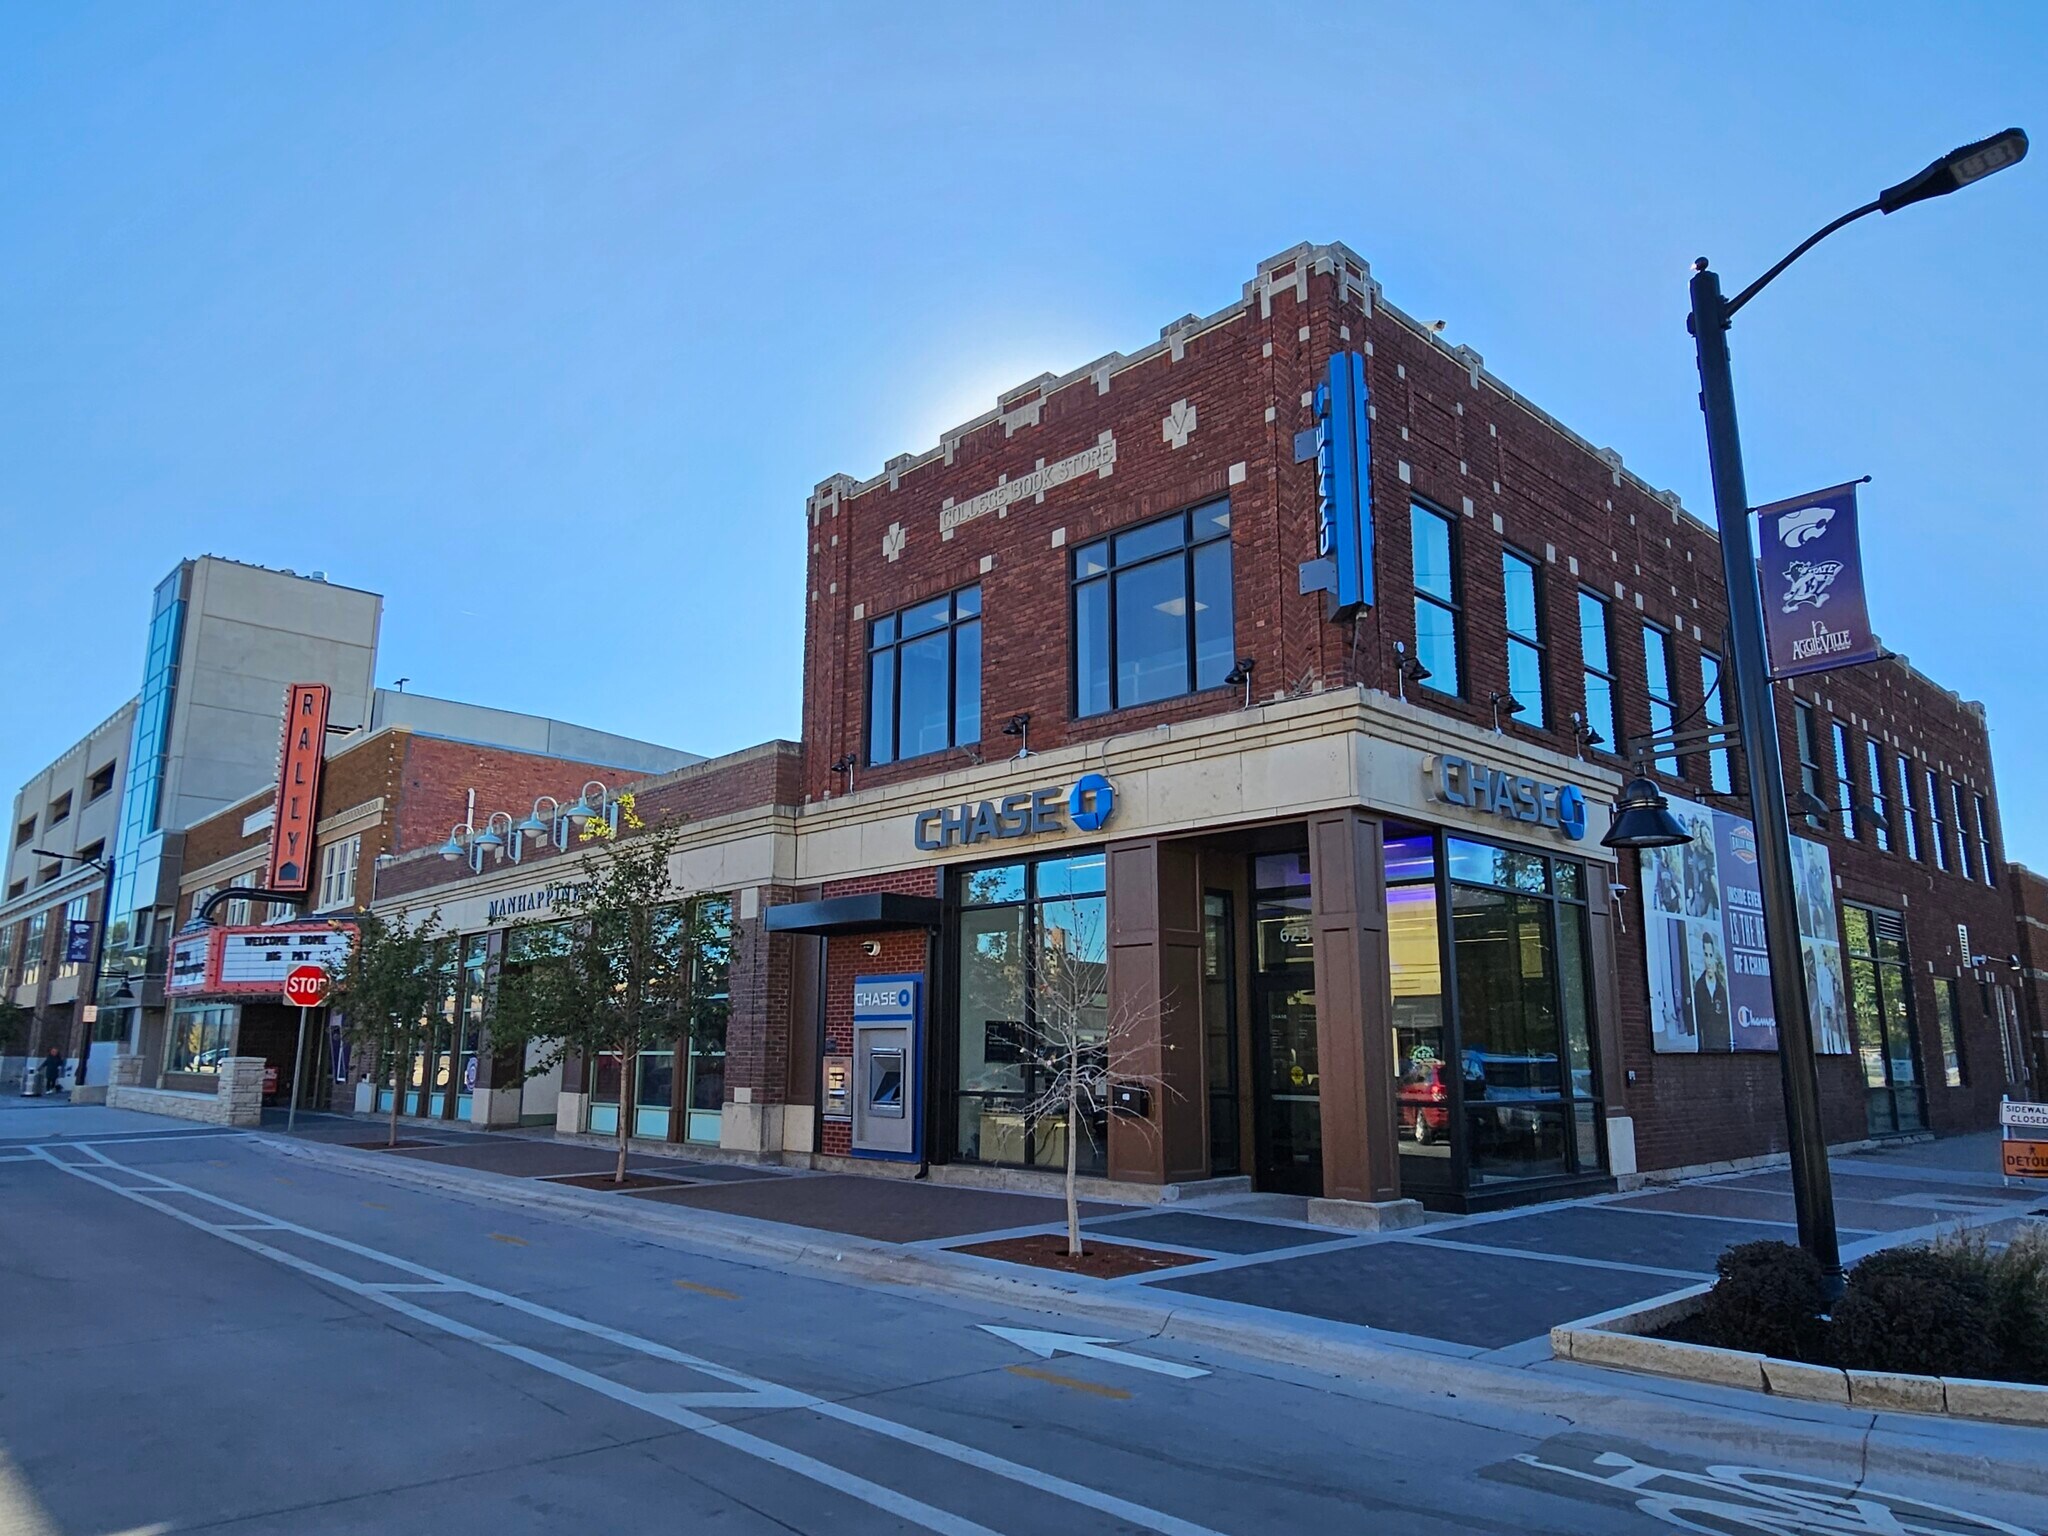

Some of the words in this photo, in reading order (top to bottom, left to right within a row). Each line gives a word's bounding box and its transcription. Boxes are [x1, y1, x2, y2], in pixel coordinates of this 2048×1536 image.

[943, 486, 1009, 528] COLLEGE
[1011, 467, 1055, 501] BOOK
[1058, 442, 1114, 480] STORE
[1316, 419, 1334, 556] CHASE
[1793, 630, 1852, 660] AGGIEVILLE
[287, 693, 314, 857] RALLY
[1435, 754, 1560, 829] CHASE
[914, 786, 1064, 851] CHASE
[488, 882, 597, 918] MANHAPPINE
[1747, 889, 1762, 908] EVER
[244, 935, 290, 946] WELCOME
[299, 935, 328, 945] HOME
[1279, 926, 1311, 943] 623
[1729, 911, 1740, 945] IS
[1739, 913, 1756, 947] THE
[1755, 916, 1768, 949] HE
[292, 951, 312, 961] PAT
[1734, 953, 1743, 974] OF
[1749, 955, 1771, 977] CHAM
[855, 991, 898, 1007] CHASE
[1738, 1005, 1777, 1036] Champ
[2006, 1105, 2048, 1115] SIDEWAL
[2010, 1114, 2048, 1125] CLOSED
[2007, 1155, 2048, 1168] DETOU
